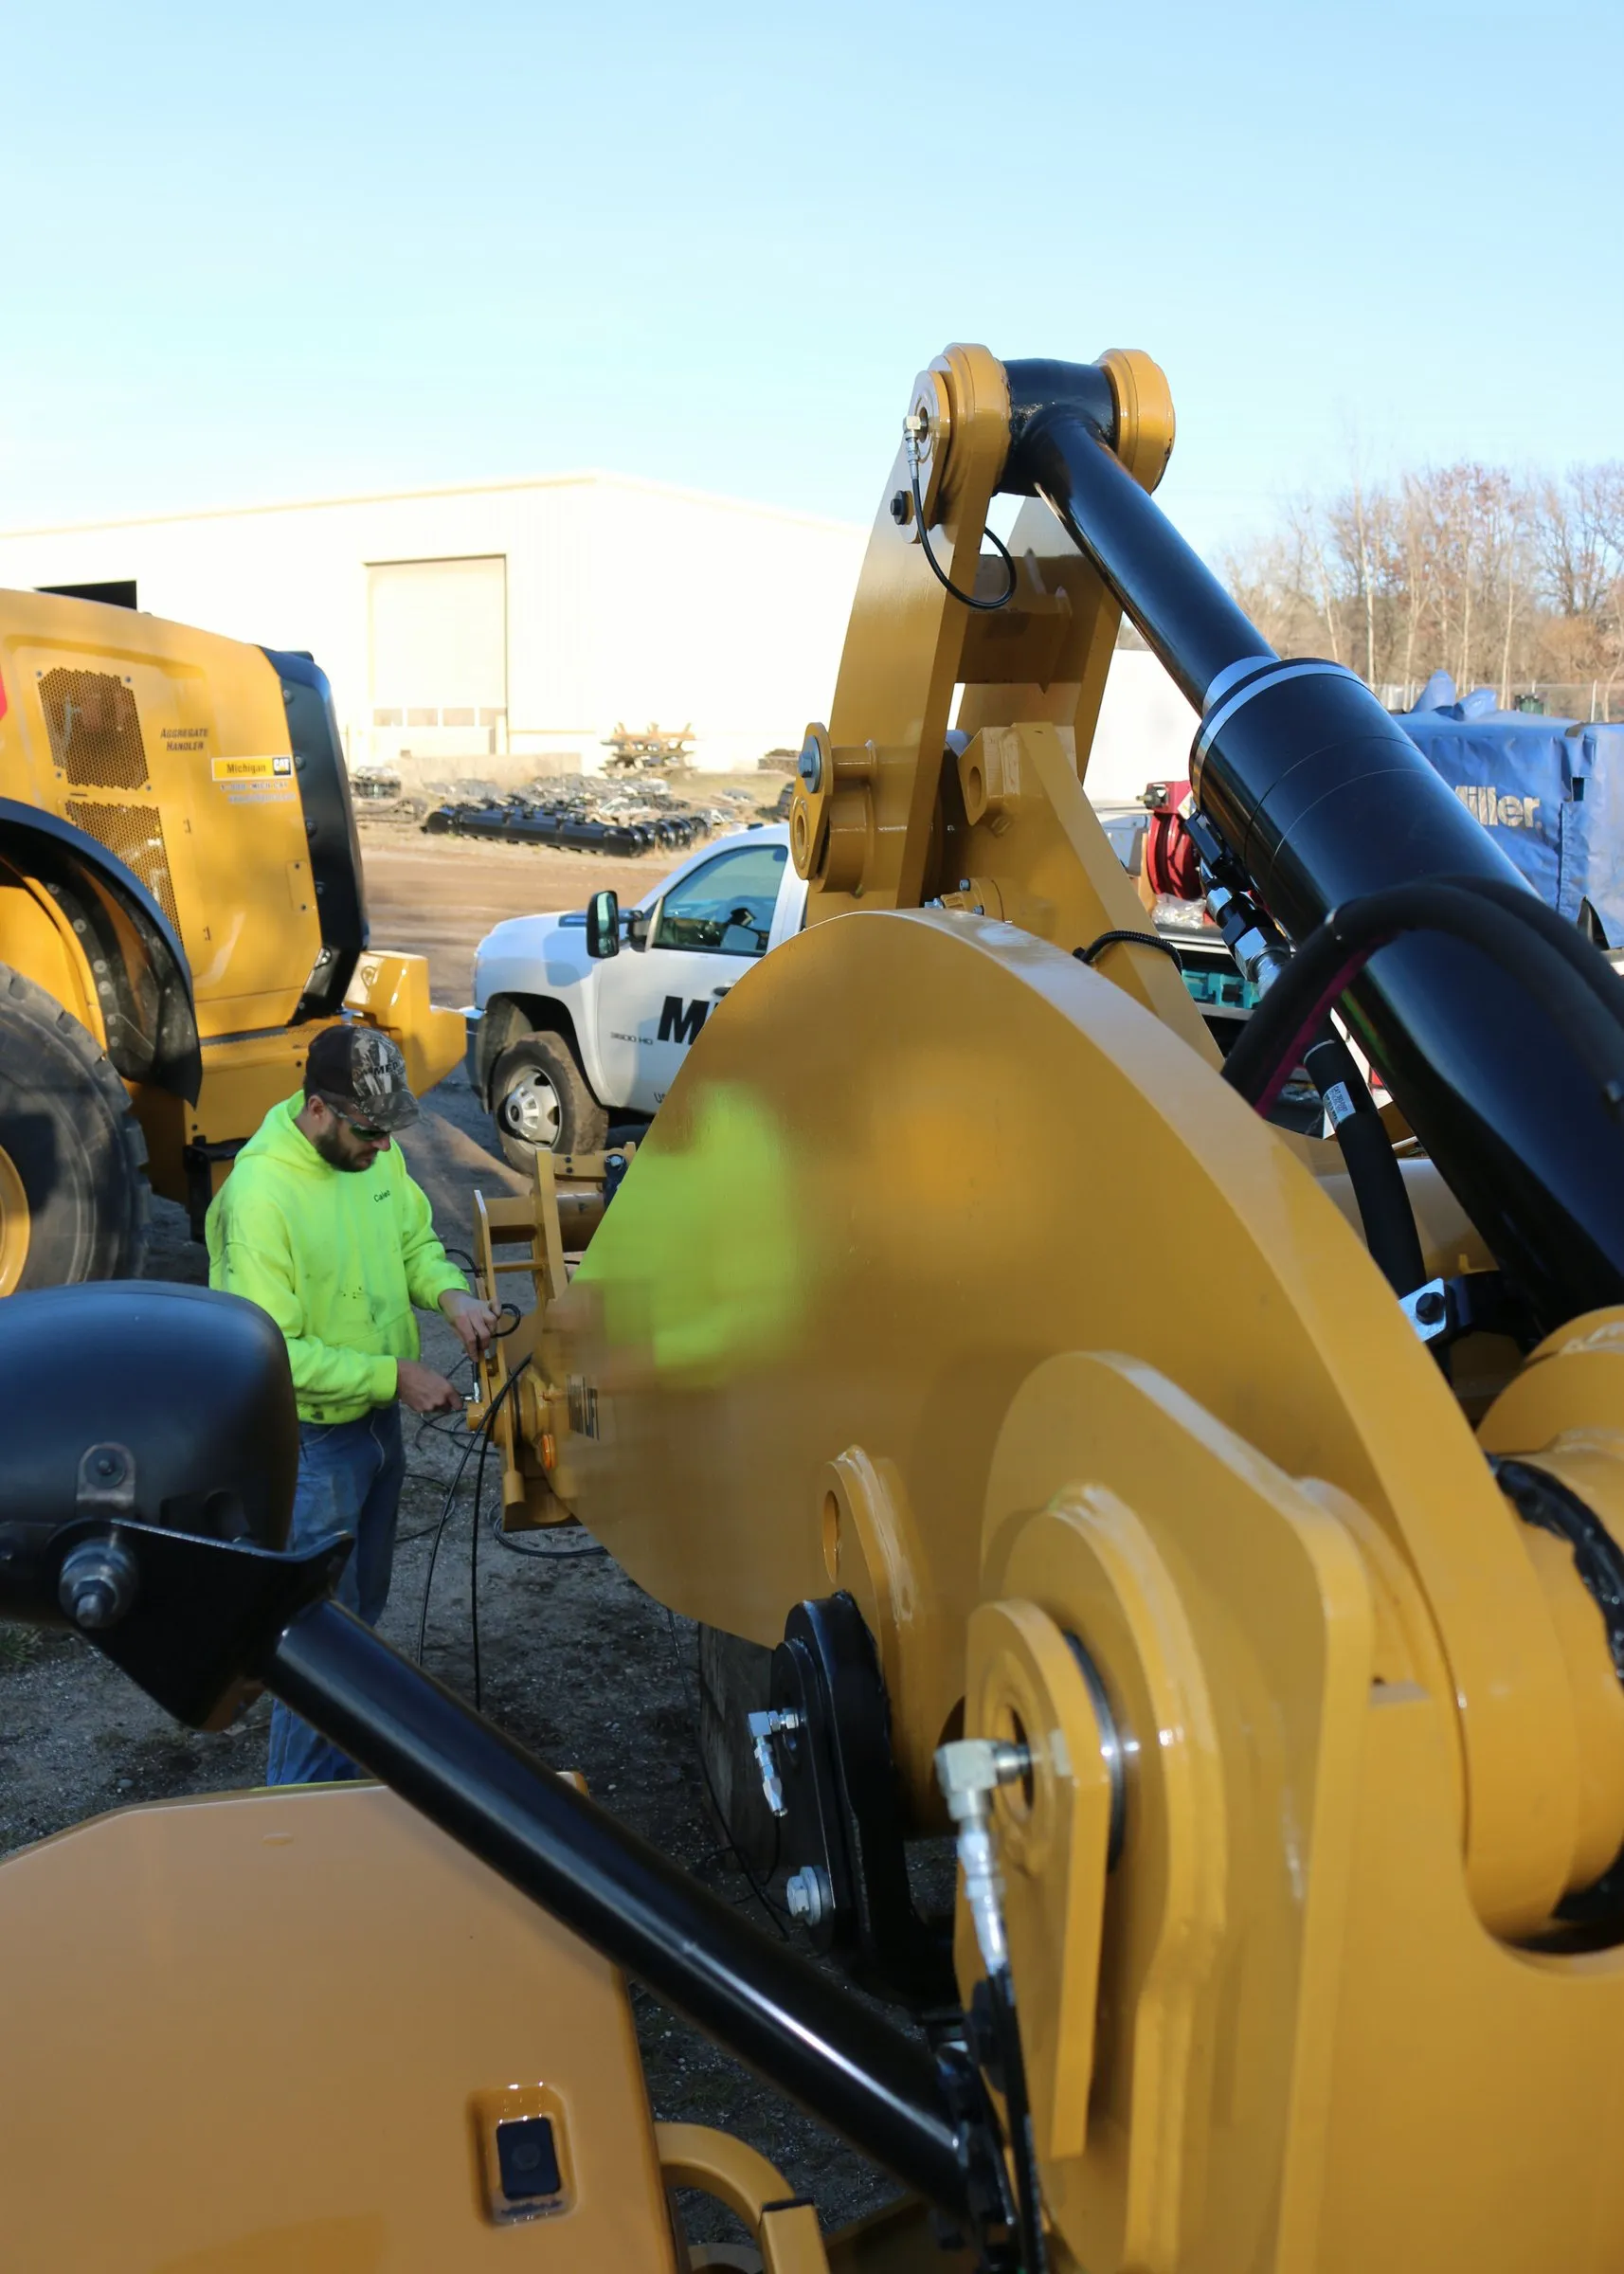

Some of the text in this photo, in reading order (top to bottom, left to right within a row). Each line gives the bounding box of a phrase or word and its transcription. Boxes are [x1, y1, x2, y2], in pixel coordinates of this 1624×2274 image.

[160, 728, 208, 738] AGGREGATE
[166, 740, 204, 751] HANDLER
[226, 763, 266, 774] Michigan
[273, 757, 290, 772] CAT
[657, 995, 719, 1045] M
